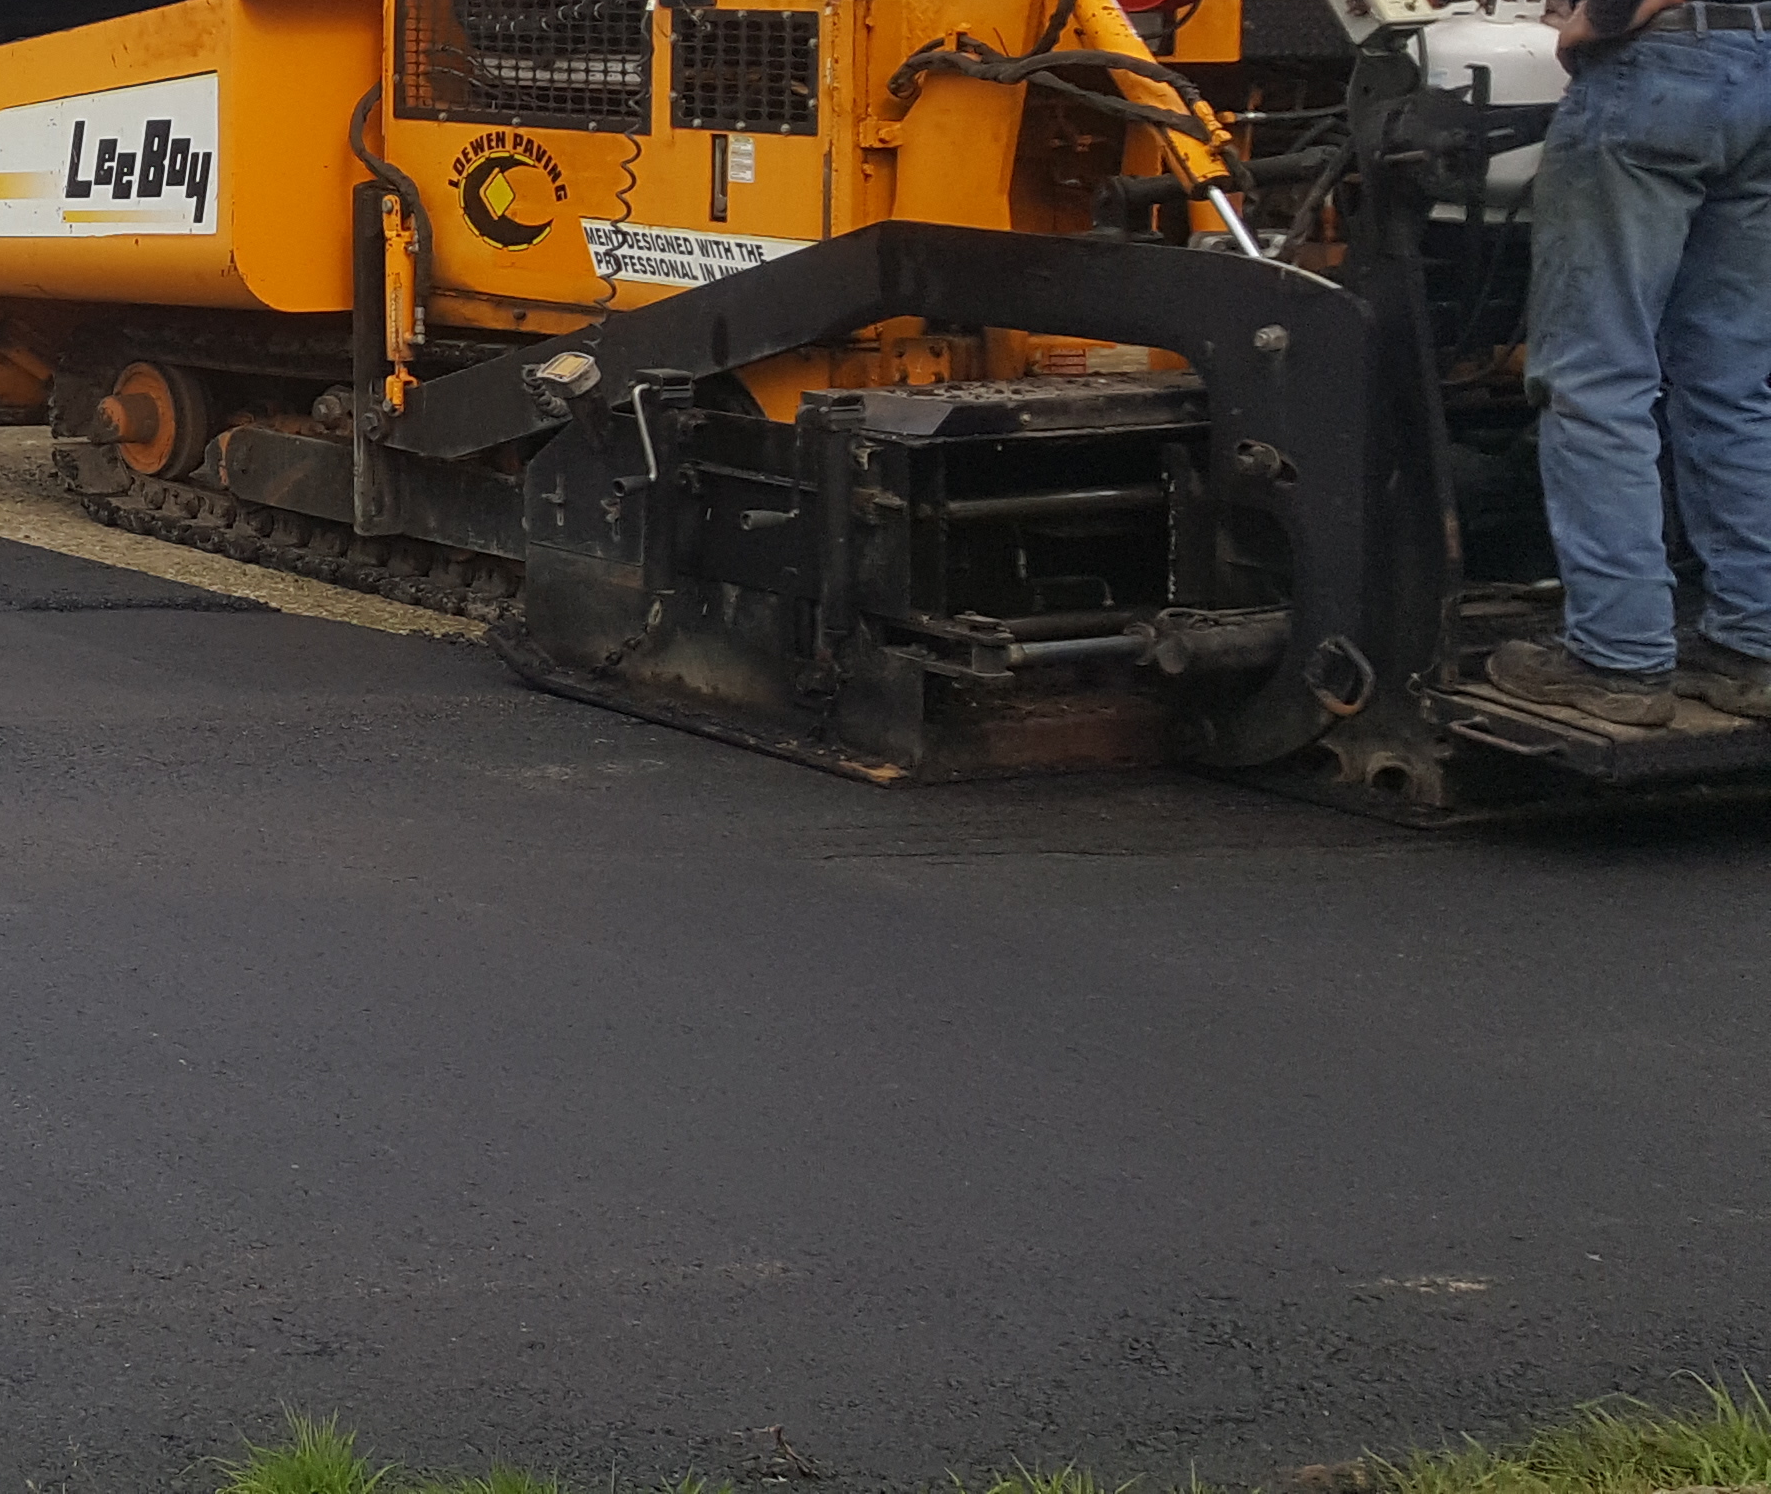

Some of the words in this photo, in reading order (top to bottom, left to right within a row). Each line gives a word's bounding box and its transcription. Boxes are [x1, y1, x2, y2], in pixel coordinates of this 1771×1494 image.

[64, 119, 213, 224] LeeBoy
[448, 131, 506, 189] LOEWEN
[512, 133, 568, 202] PAVING
[583, 226, 621, 248] MENT
[624, 230, 694, 256] DESIGNED
[695, 237, 735, 261] WITH
[735, 242, 766, 264] THE
[699, 263, 716, 282] IN
